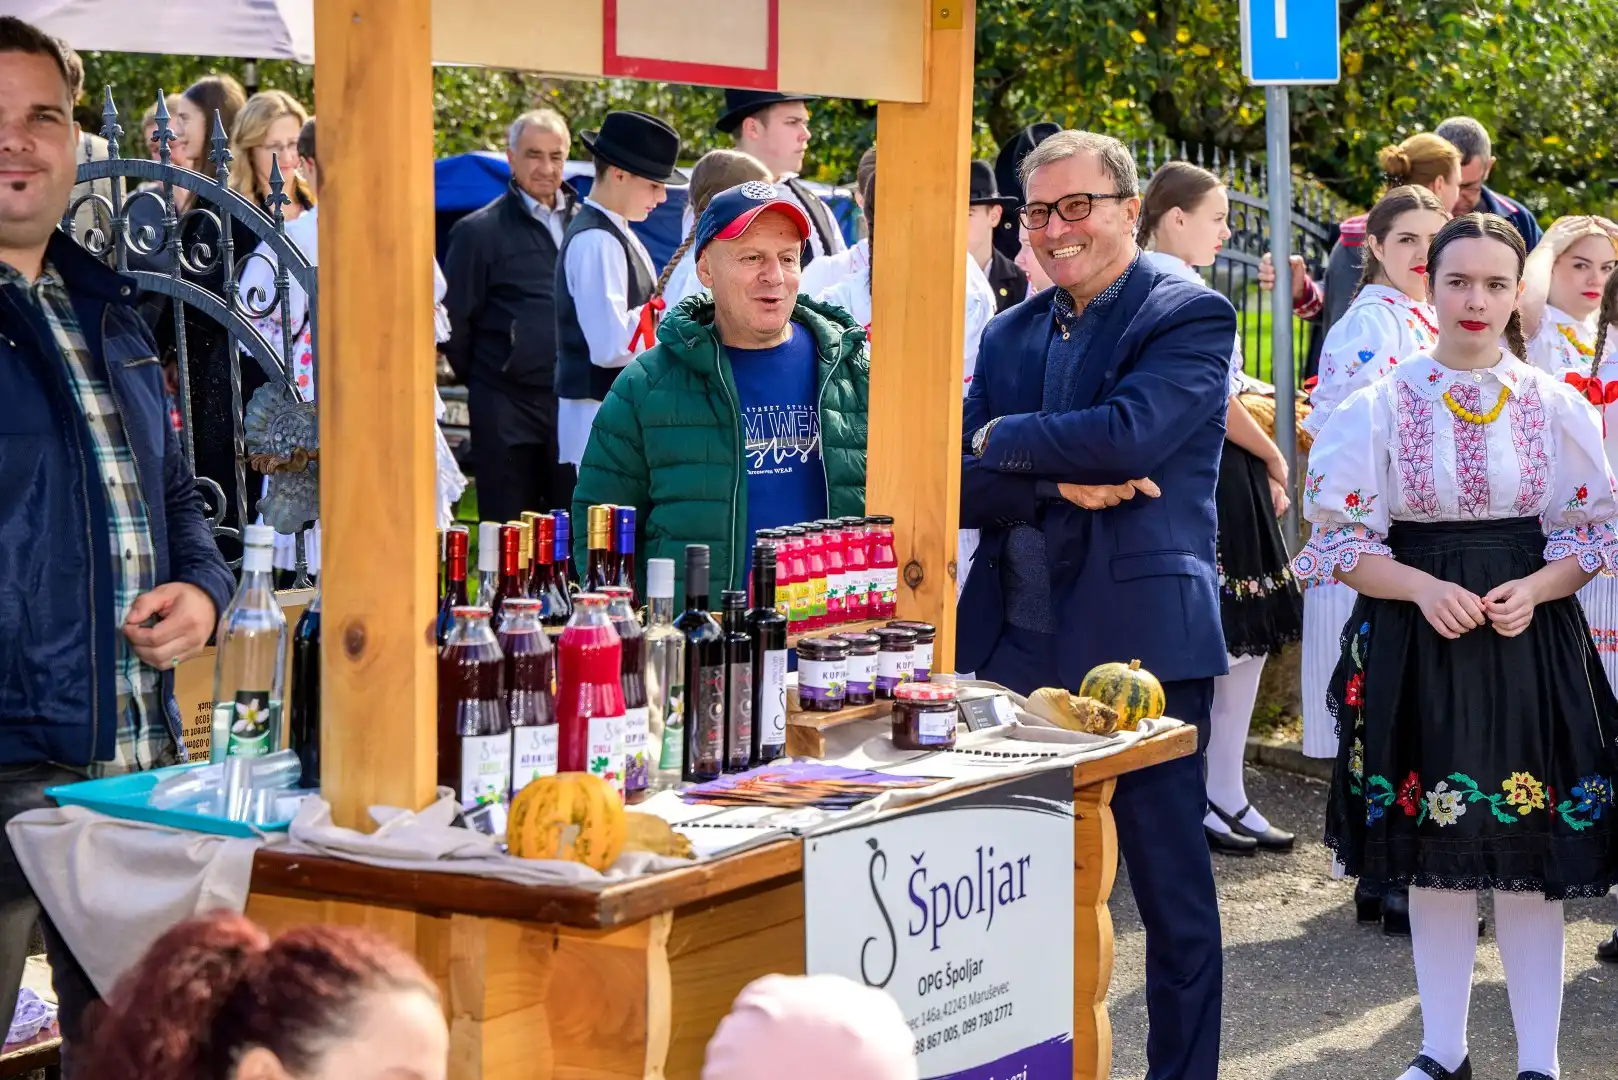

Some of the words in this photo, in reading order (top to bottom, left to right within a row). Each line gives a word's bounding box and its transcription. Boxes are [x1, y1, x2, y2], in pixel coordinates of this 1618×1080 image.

[908, 845, 1030, 951] Špoljar
[918, 970, 943, 996] OPG
[946, 958, 983, 989] Špoljar
[969, 981, 1010, 1005] Maruševec
[927, 1032, 941, 1050] 867
[962, 1018, 977, 1035] 099
[979, 1011, 993, 1029] 730
[995, 1002, 1012, 1022] 2772
